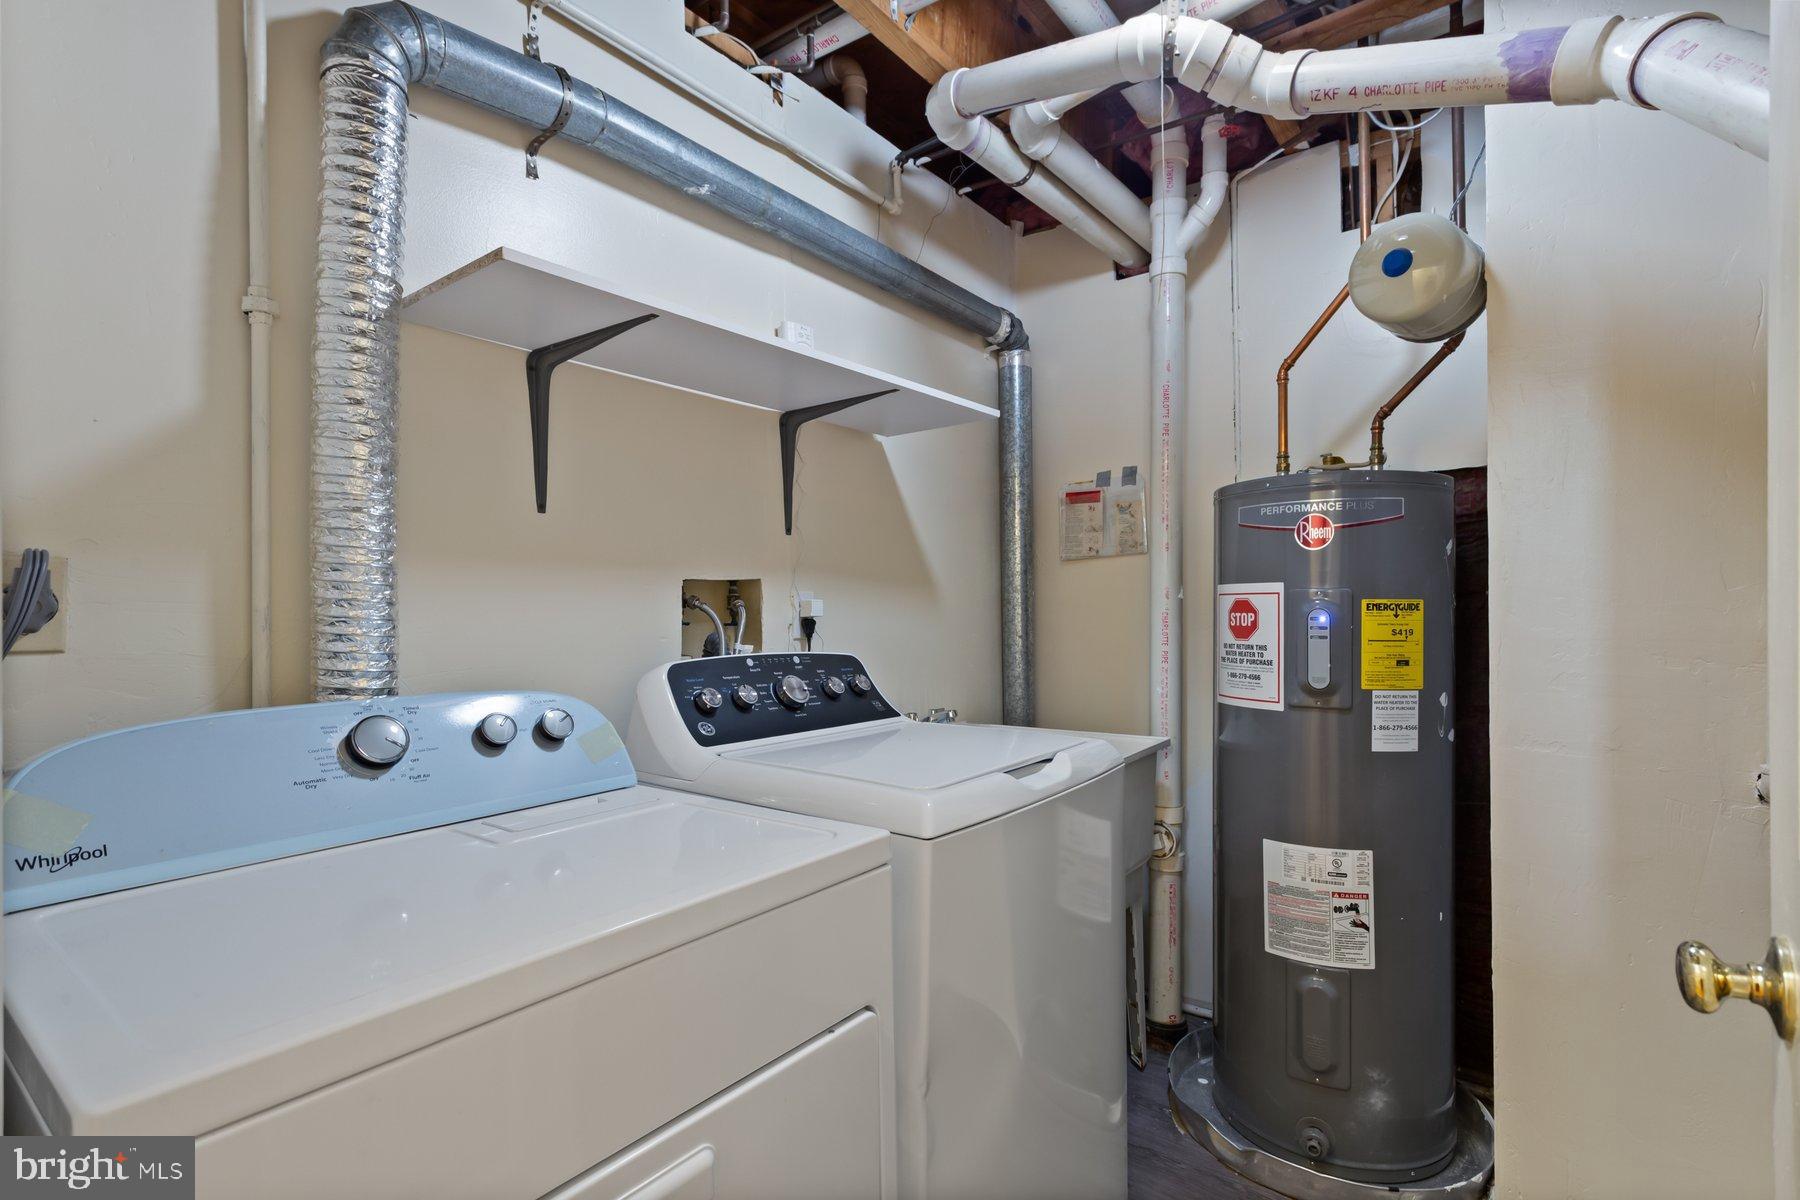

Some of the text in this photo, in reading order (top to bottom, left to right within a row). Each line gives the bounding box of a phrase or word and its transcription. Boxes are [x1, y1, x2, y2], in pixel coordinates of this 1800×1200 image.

[1348, 86, 1358, 98] 4
[1364, 82, 1420, 97] CHARLOTTE
[1424, 80, 1447, 93] PIPE
[1162, 421, 1170, 437] PIPE
[1260, 501, 1375, 516] PERFORMANCE PLUS
[1300, 516, 1332, 544] Rheem
[1230, 612, 1255, 627] STOP
[1238, 650, 1256, 658] HEATER
[1255, 643, 1268, 651] THIS
[1246, 658, 1274, 666] PURCHASE
[293, 777, 327, 787] Automatic
[15, 844, 108, 873] Whirlpool
